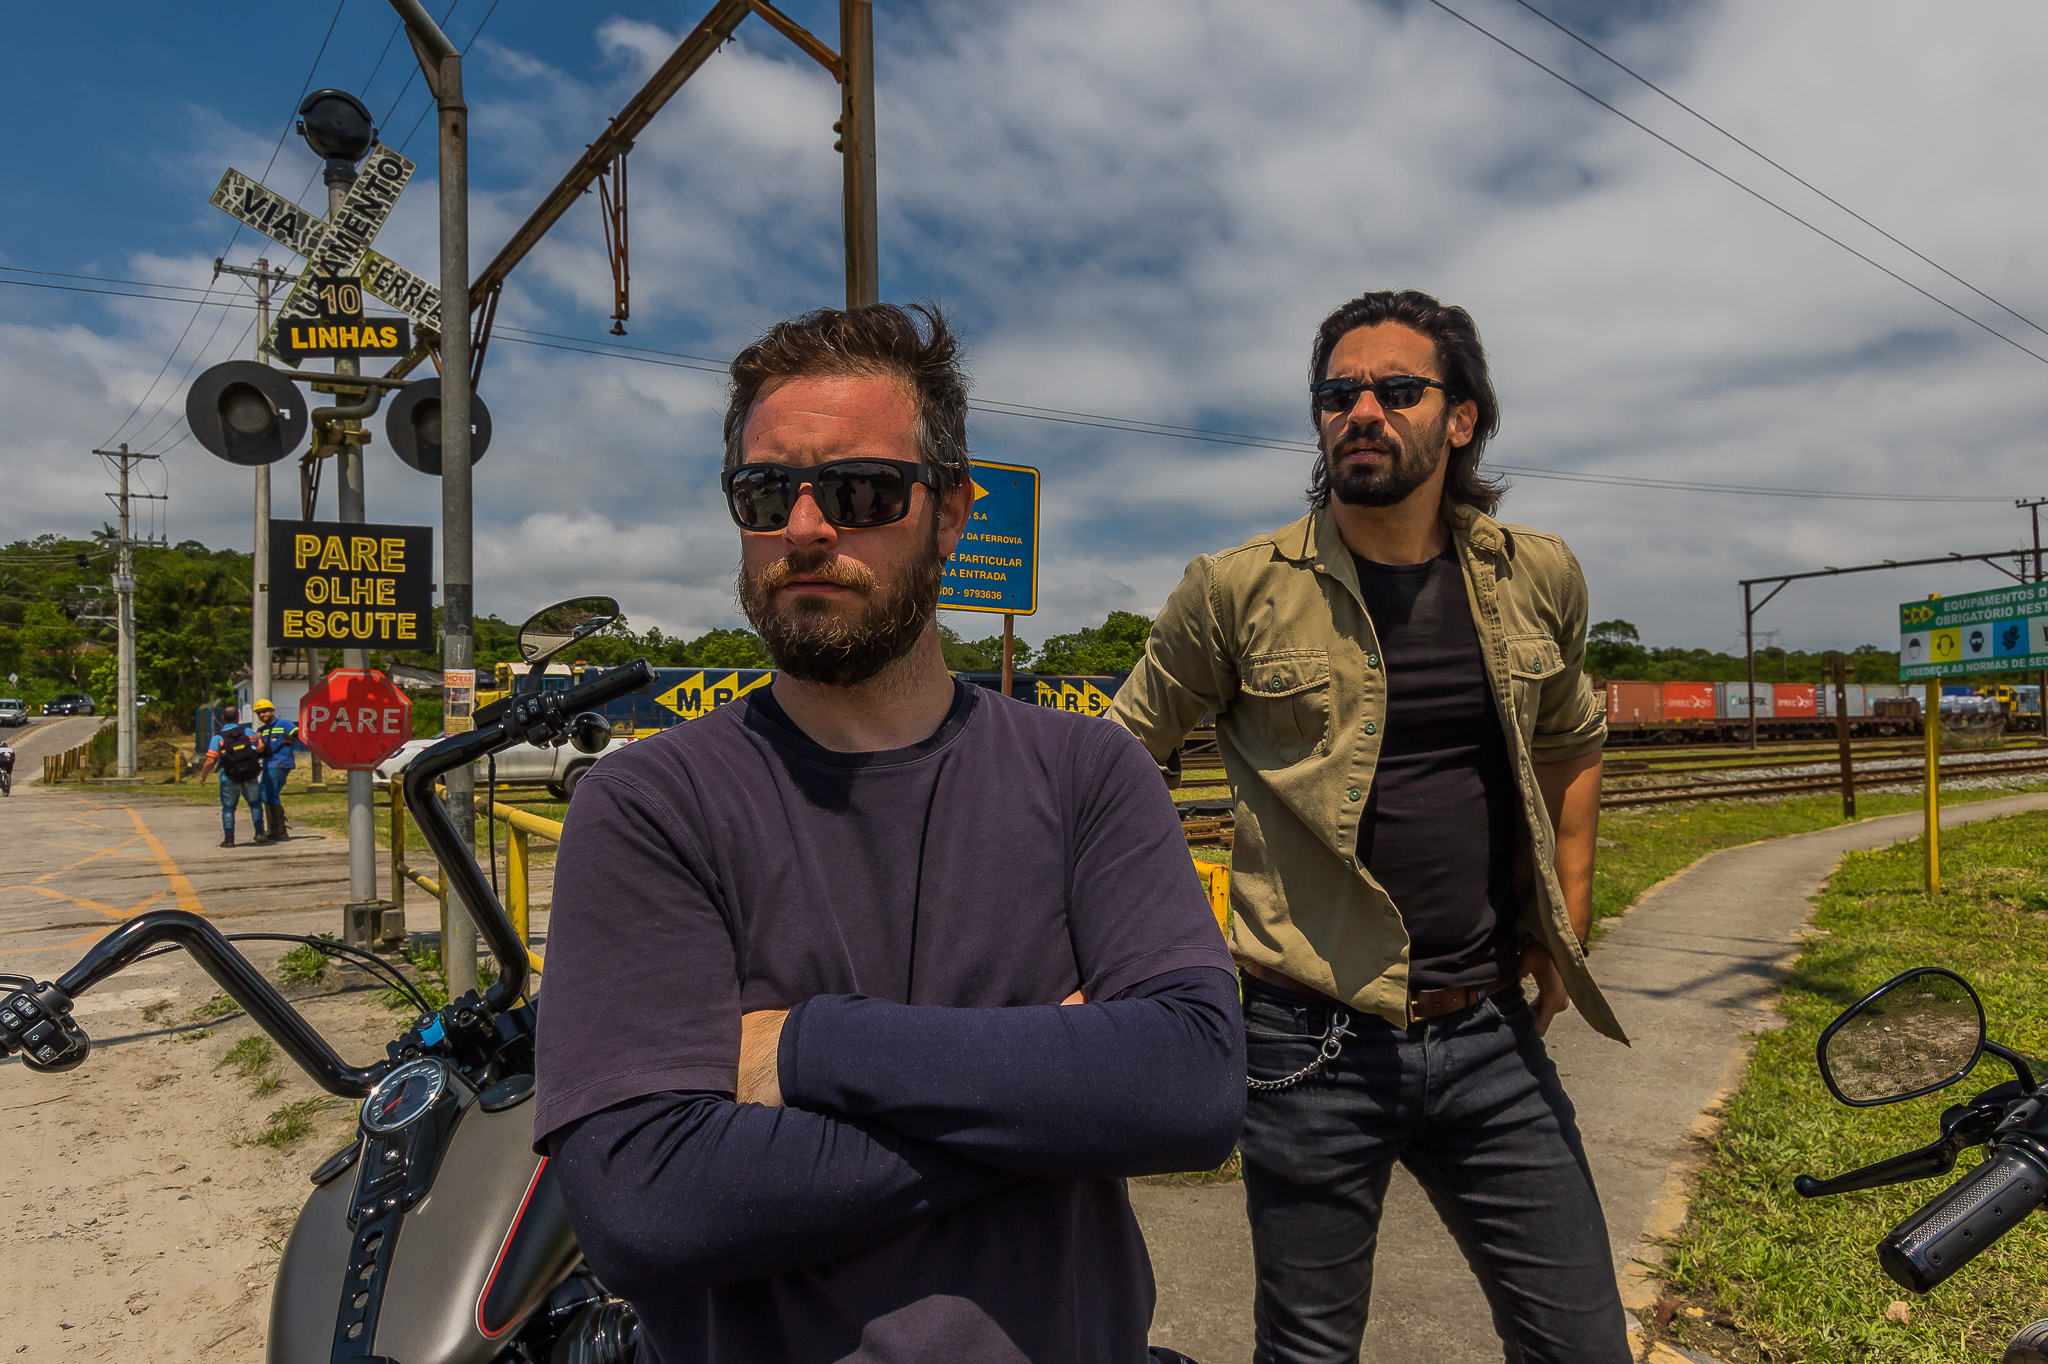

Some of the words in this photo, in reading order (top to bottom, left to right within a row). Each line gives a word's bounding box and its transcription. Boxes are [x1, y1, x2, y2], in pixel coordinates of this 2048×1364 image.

[244, 187, 297, 238] VIA
[320, 284, 360, 315] 10
[291, 326, 399, 349] LINHAS
[966, 532, 979, 541] DA
[980, 533, 1023, 545] FERROVIA
[295, 534, 406, 572] PARE
[959, 553, 1023, 567] PARTICULAR
[949, 568, 957, 578] A
[959, 568, 1007, 581] ENTRADA
[305, 576, 396, 606] OLHE
[963, 588, 1002, 600] 9793636
[1943, 588, 2035, 612] EQUIPAMENTOS
[283, 610, 417, 639] ESCUTE
[1935, 606, 2013, 626] OBRIGATÓRIO
[1951, 663, 1964, 674] AS
[1966, 659, 2008, 672] NORMAS
[2011, 658, 2026, 668] DE
[1039, 692, 1101, 712] MRS
[310, 706, 401, 735] PARE
